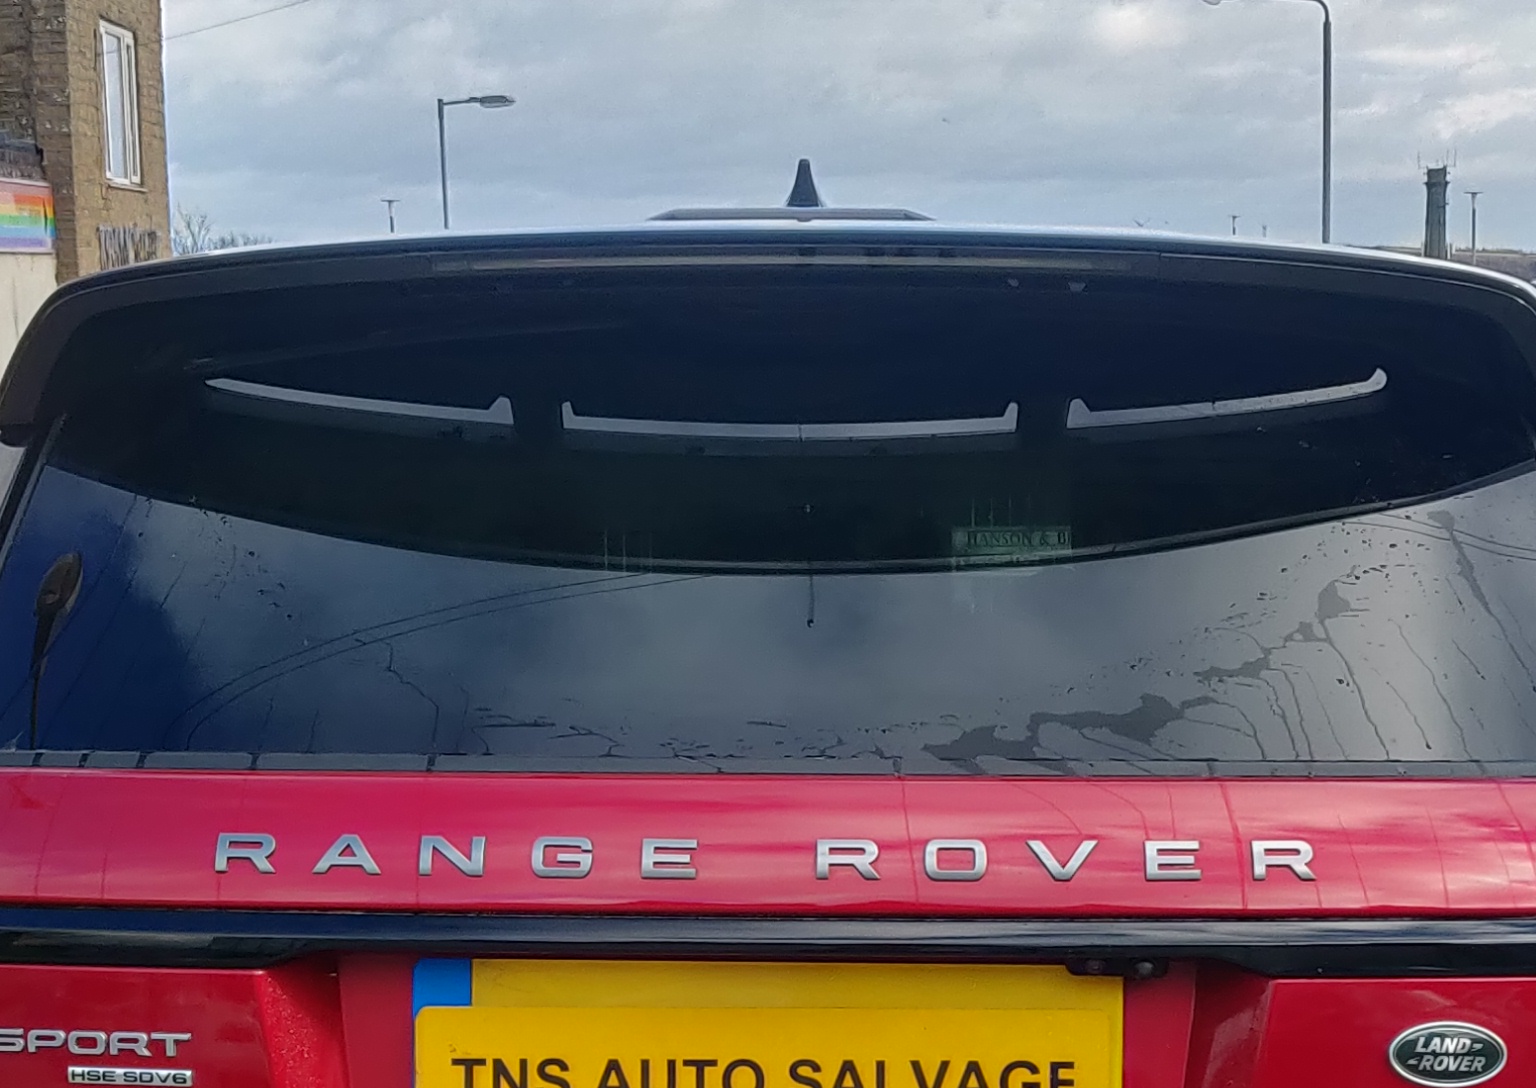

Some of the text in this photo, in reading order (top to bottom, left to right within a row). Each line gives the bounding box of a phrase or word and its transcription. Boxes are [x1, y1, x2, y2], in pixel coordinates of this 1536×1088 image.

[214, 832, 1318, 881] RANGE ROVER
[70, 1069, 188, 1085] HSE SDV6
